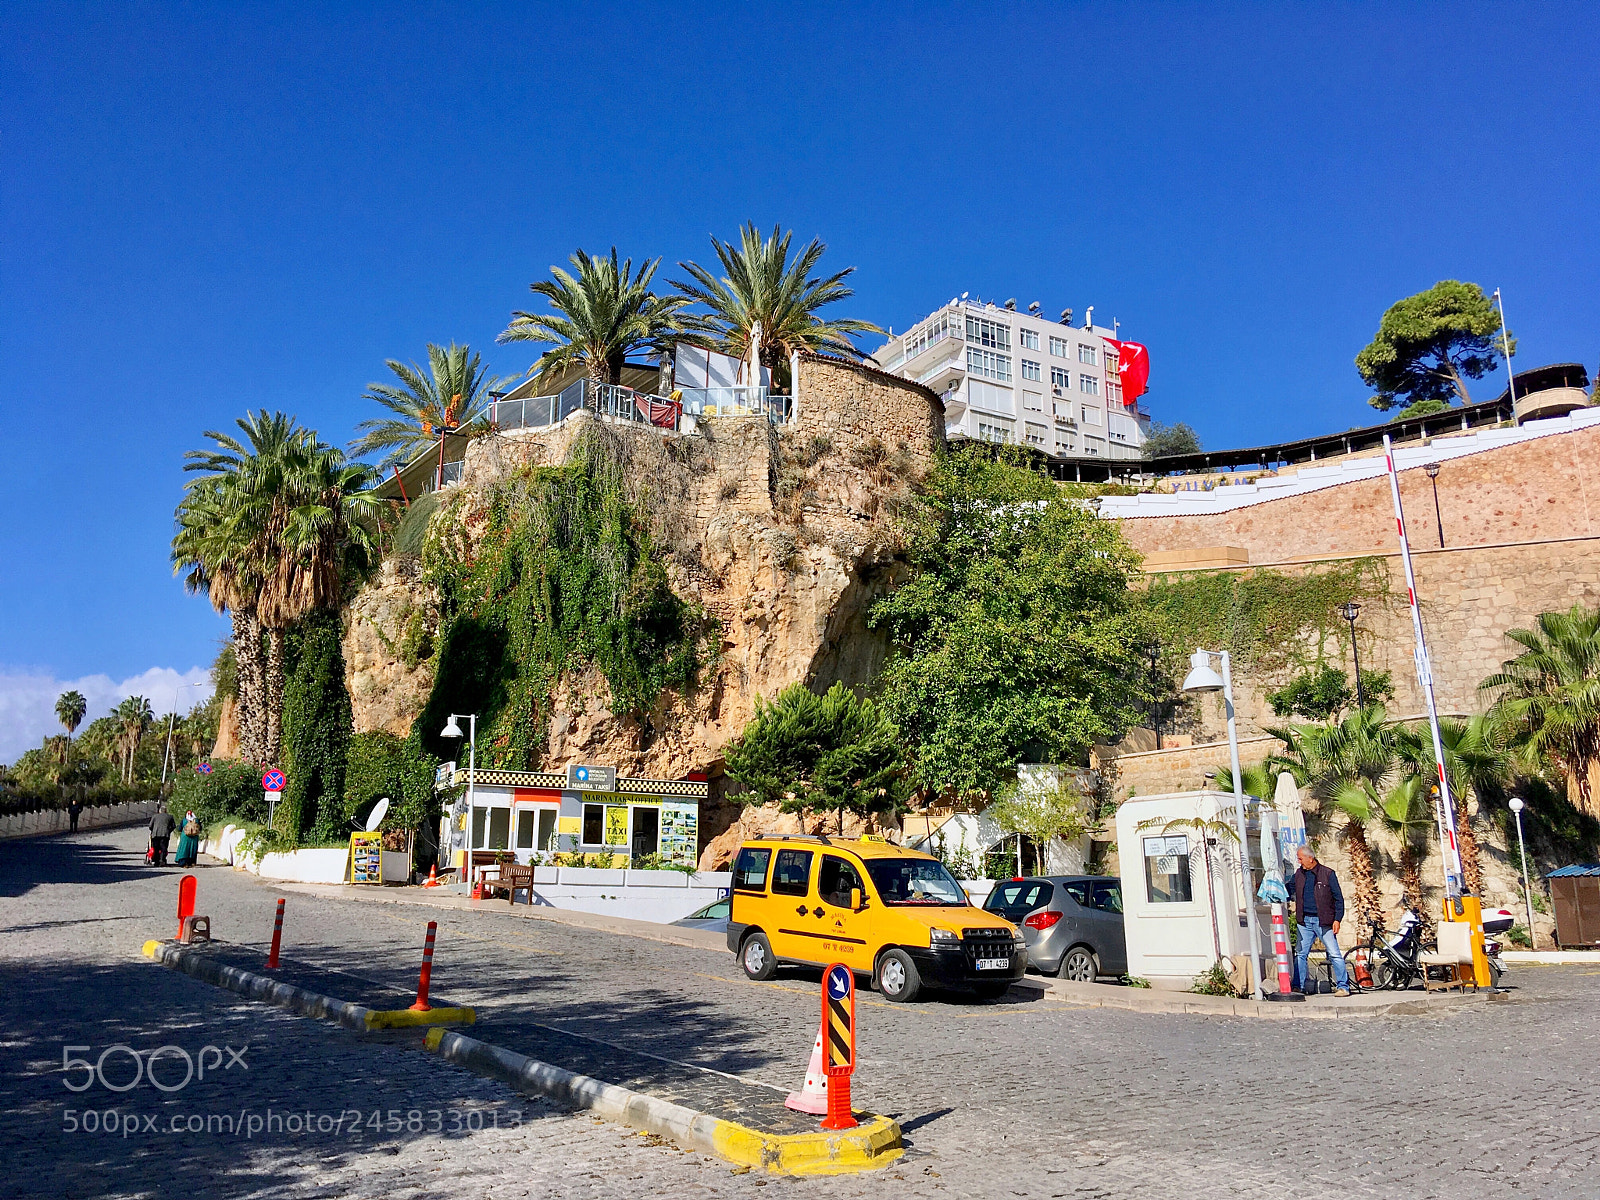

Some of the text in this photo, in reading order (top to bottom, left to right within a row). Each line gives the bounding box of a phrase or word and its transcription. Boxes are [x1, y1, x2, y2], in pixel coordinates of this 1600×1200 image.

[634, 796, 659, 804] OFFICE
[607, 827, 627, 835] TAXI
[718, 888, 727, 900] P
[980, 960, 987, 969] 07
